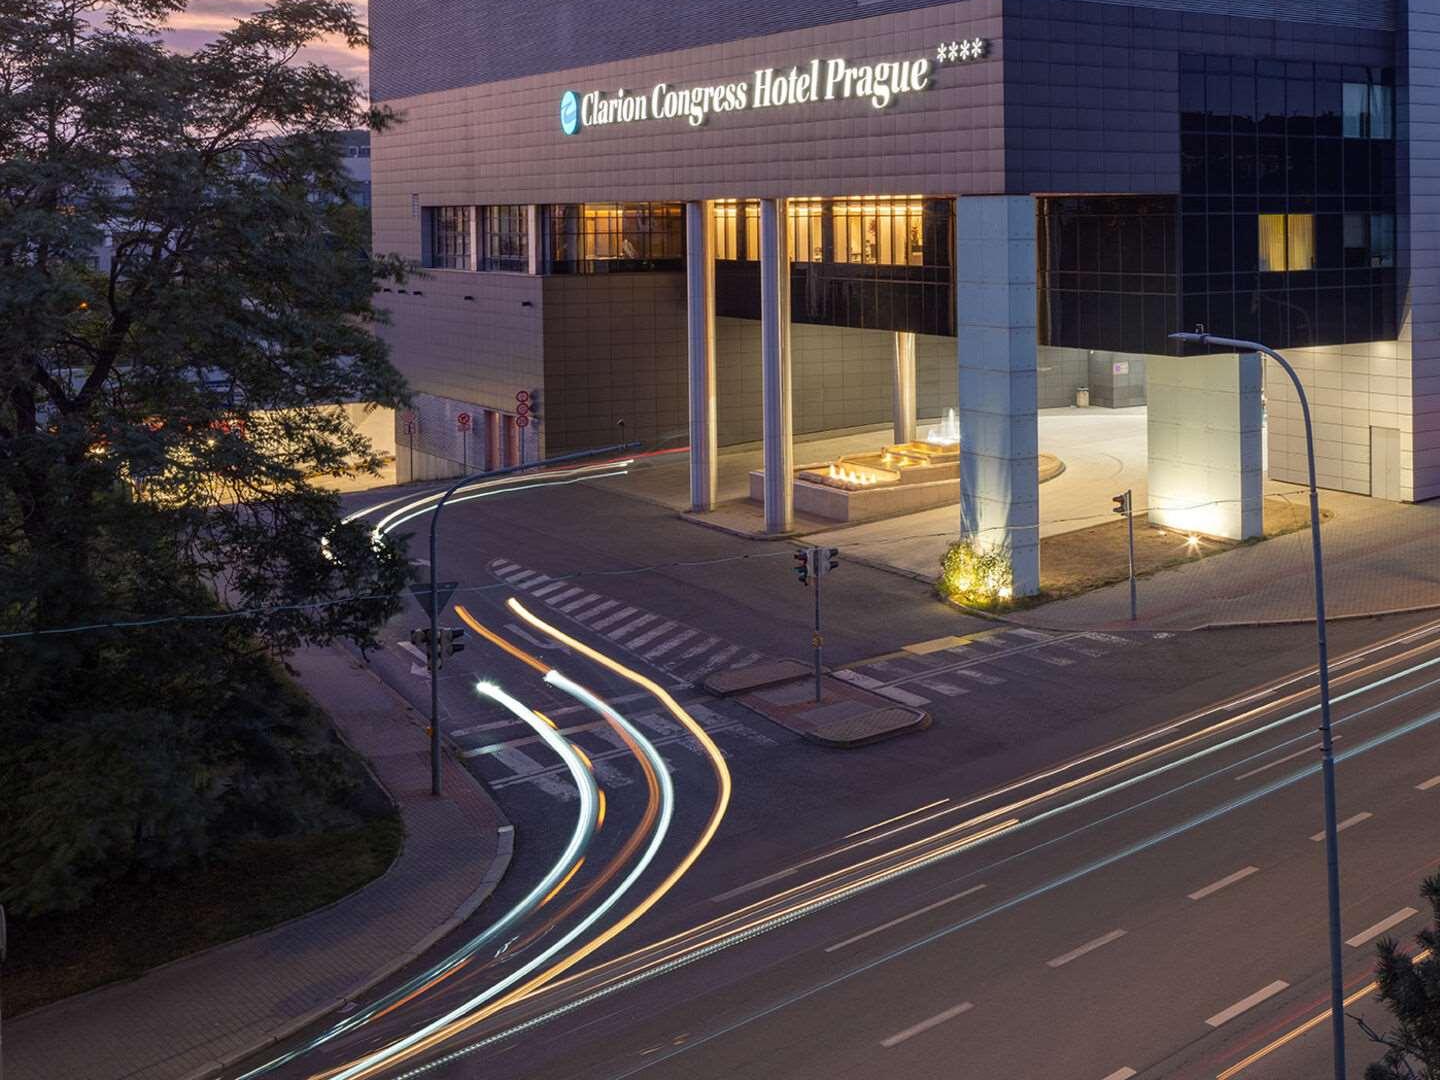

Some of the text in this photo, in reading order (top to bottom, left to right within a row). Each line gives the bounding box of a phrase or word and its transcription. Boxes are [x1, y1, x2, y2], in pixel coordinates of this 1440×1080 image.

[581, 58, 929, 126] Clarion Congress Hotel Prague
